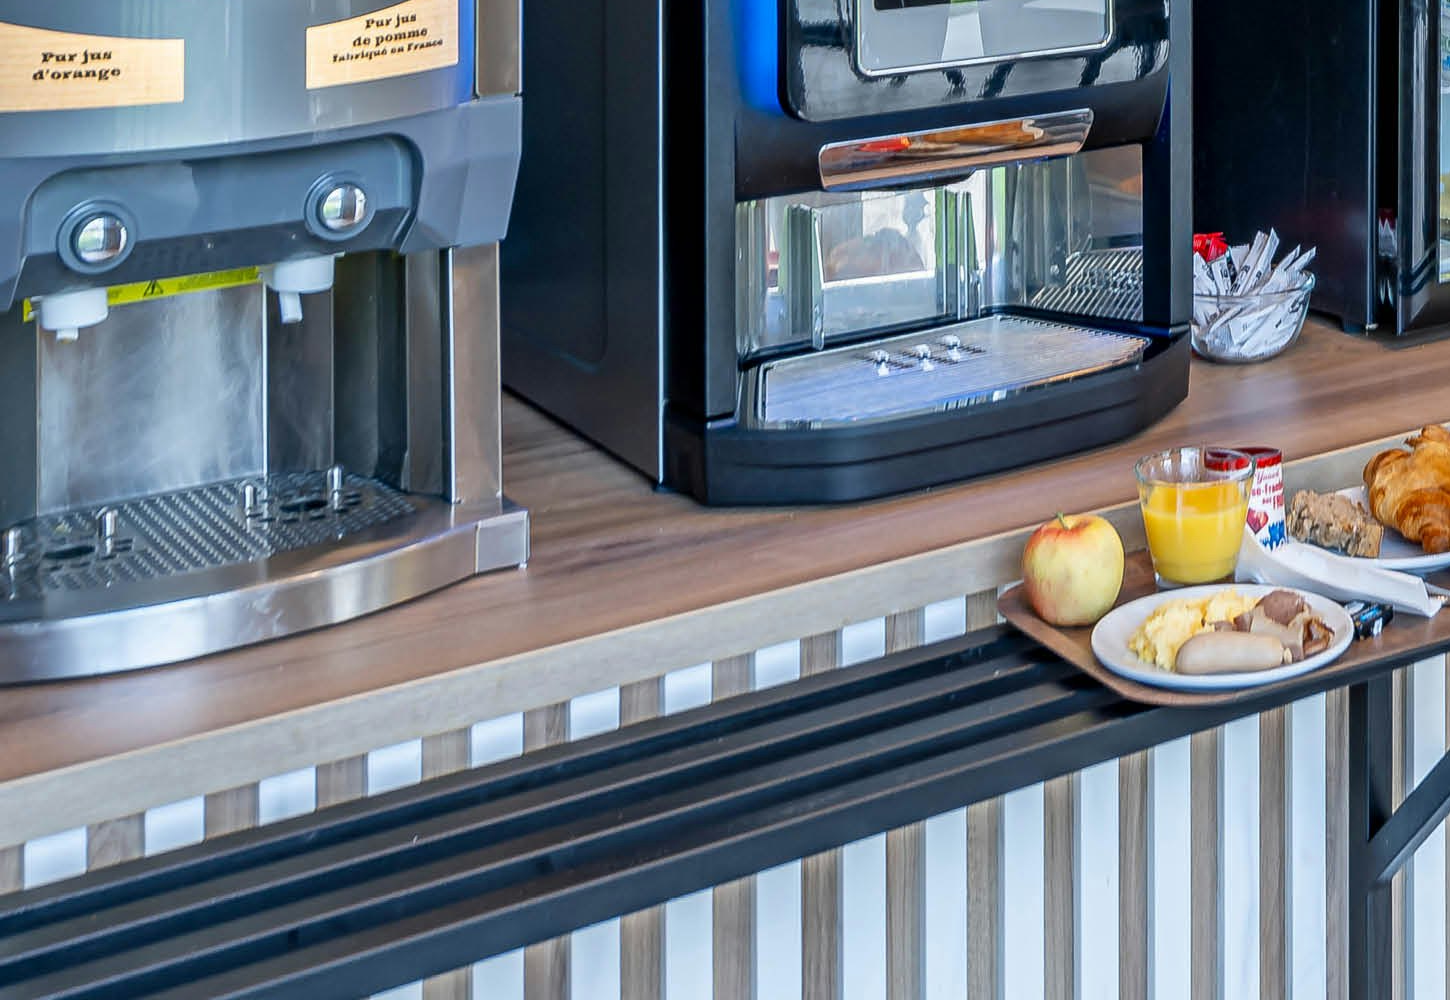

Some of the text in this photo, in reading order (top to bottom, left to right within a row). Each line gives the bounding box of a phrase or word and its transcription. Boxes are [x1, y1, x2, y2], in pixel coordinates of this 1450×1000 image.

[365, 13, 417, 29] Pur jus
[353, 28, 428, 47] de pomme
[41, 49, 112, 64] Pur jus
[32, 67, 121, 81] d'orange
